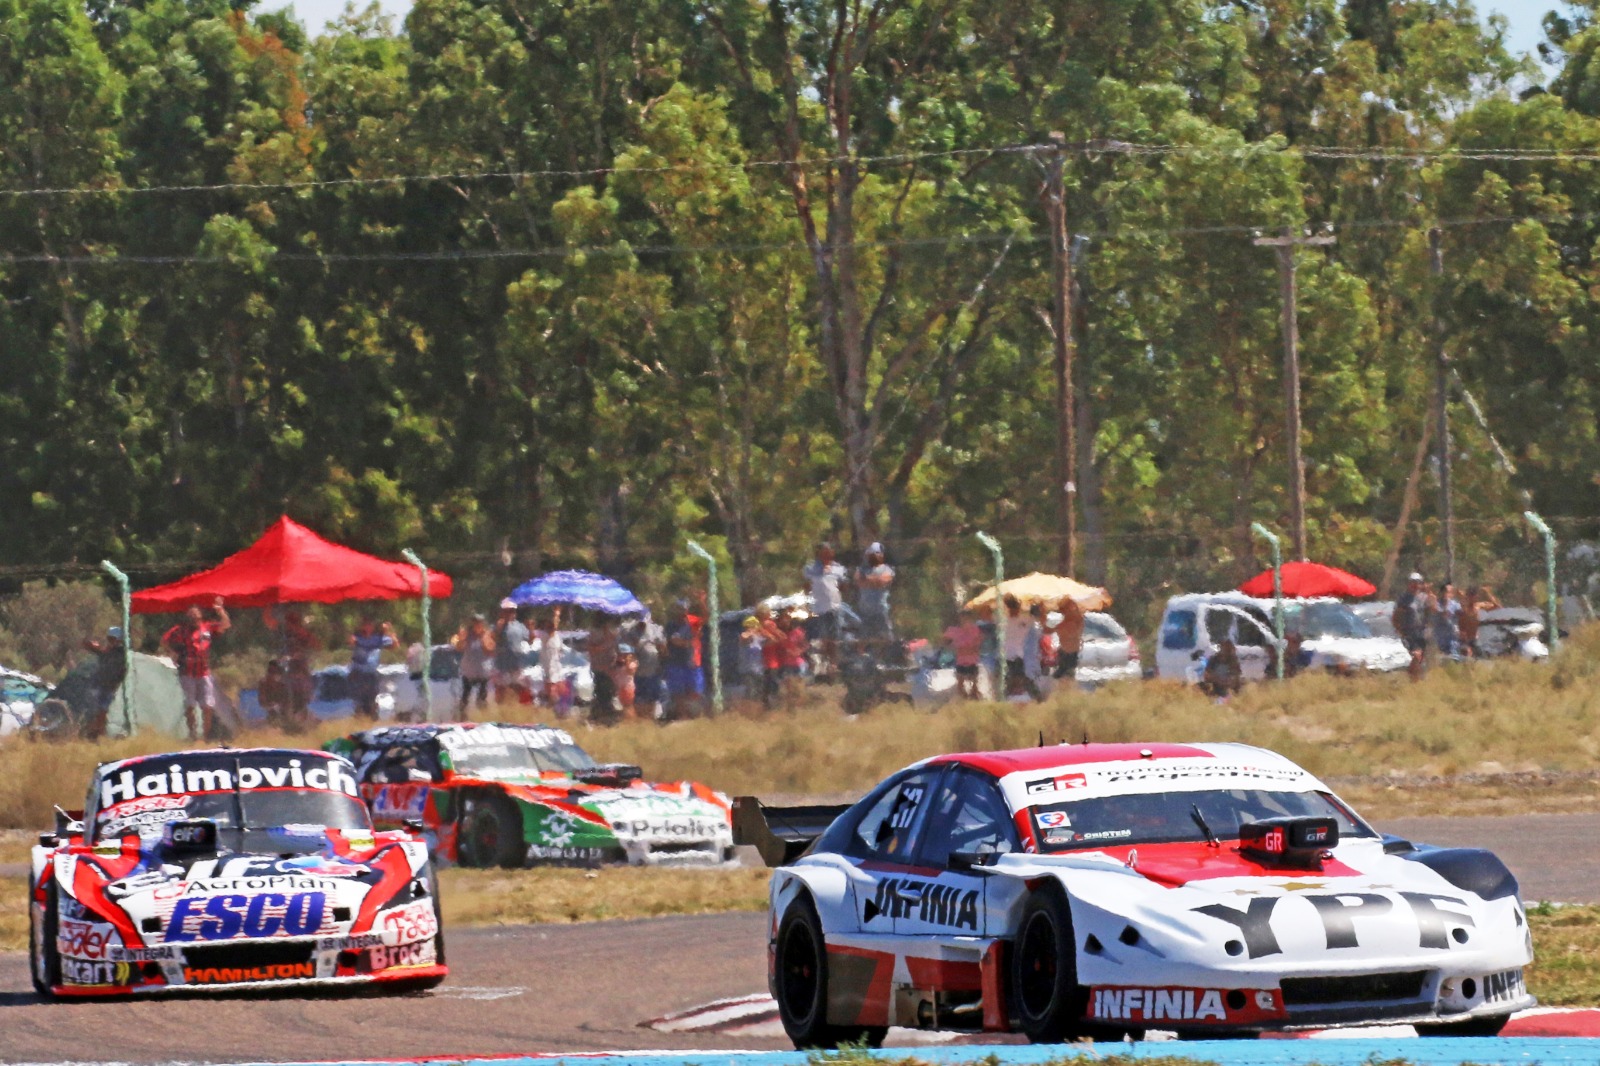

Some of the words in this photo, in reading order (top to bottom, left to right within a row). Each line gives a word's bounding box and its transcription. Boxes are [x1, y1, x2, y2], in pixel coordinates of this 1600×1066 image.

[101, 758, 359, 808] Haimovich
[1027, 775, 1087, 795] GR
[1265, 831, 1282, 851] GR
[163, 891, 327, 943] ESCO
[877, 877, 980, 931] INFINIA
[1188, 890, 1477, 960] YPF
[183, 962, 314, 983] HAMILTON
[1094, 988, 1227, 1021] INFINIA
